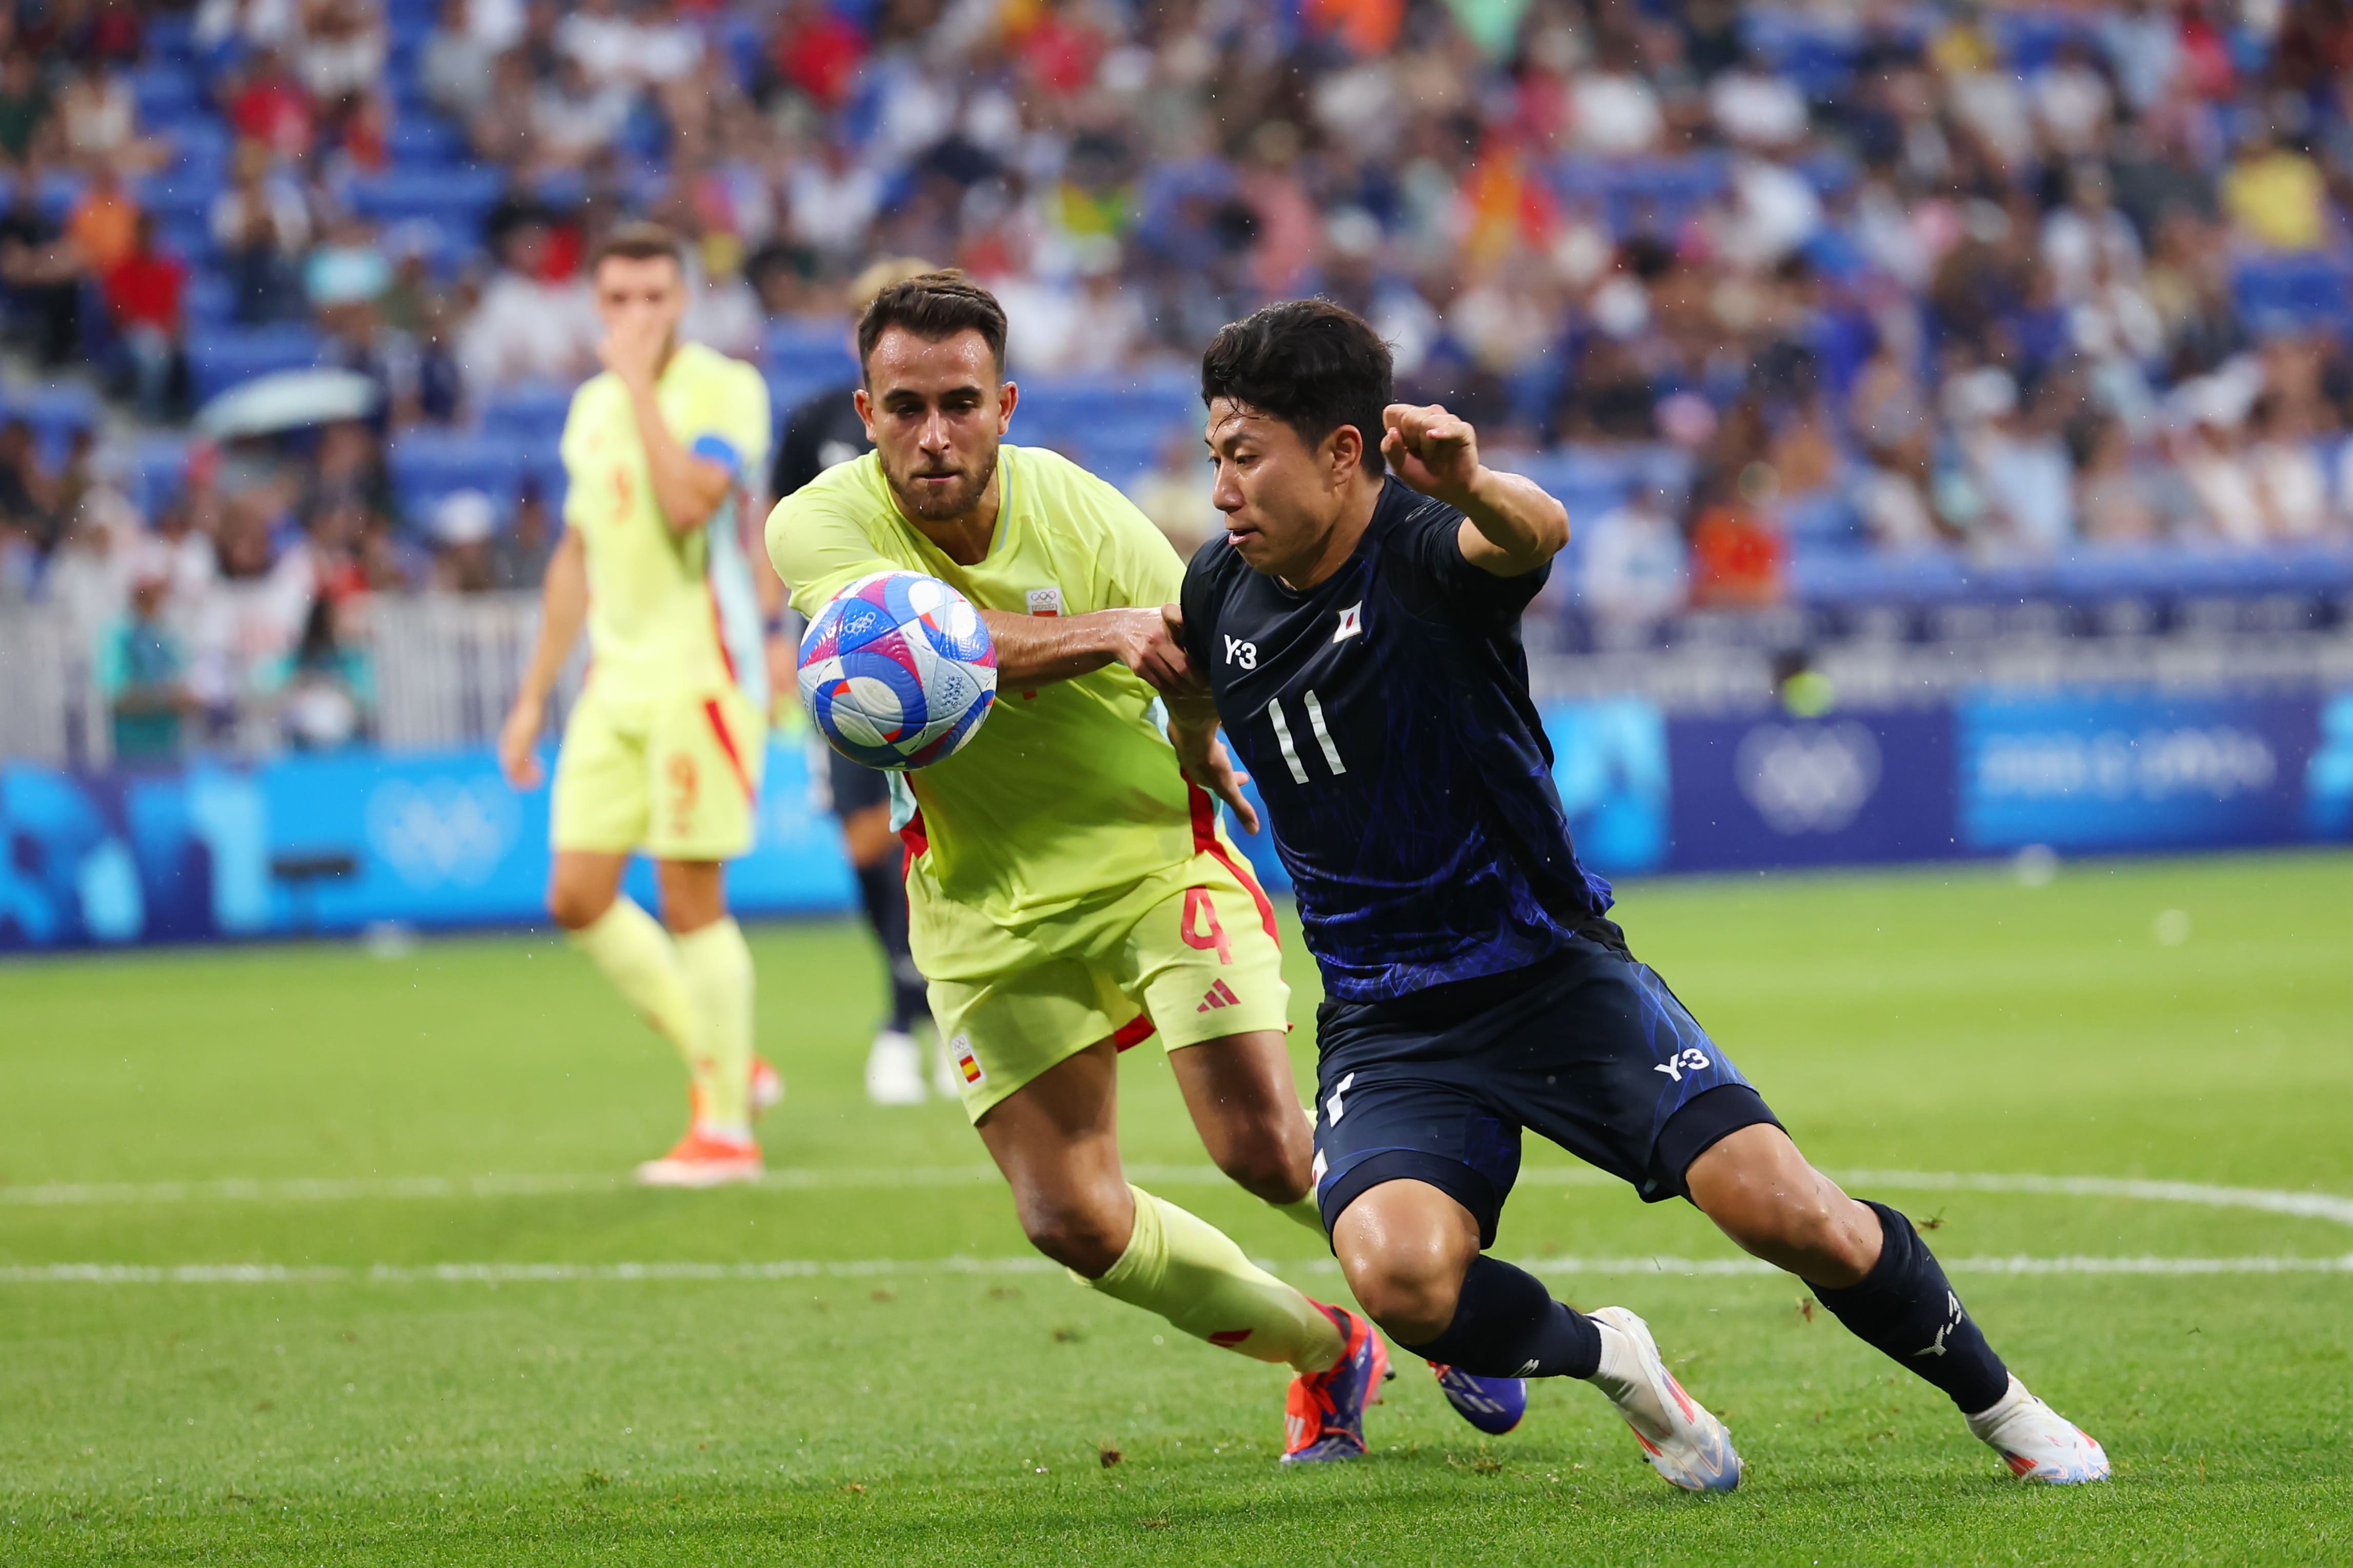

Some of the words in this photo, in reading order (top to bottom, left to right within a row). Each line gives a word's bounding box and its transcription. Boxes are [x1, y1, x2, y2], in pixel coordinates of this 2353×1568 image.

[1223, 634, 1257, 670] Y-3
[951, 676, 963, 706] PARIS
[1268, 689, 1347, 785] 11
[666, 750, 700, 839] 9
[1180, 884, 1233, 965] 4
[1653, 1048, 1710, 1082] Y-3
[1914, 1290, 1962, 1357] Y-3
